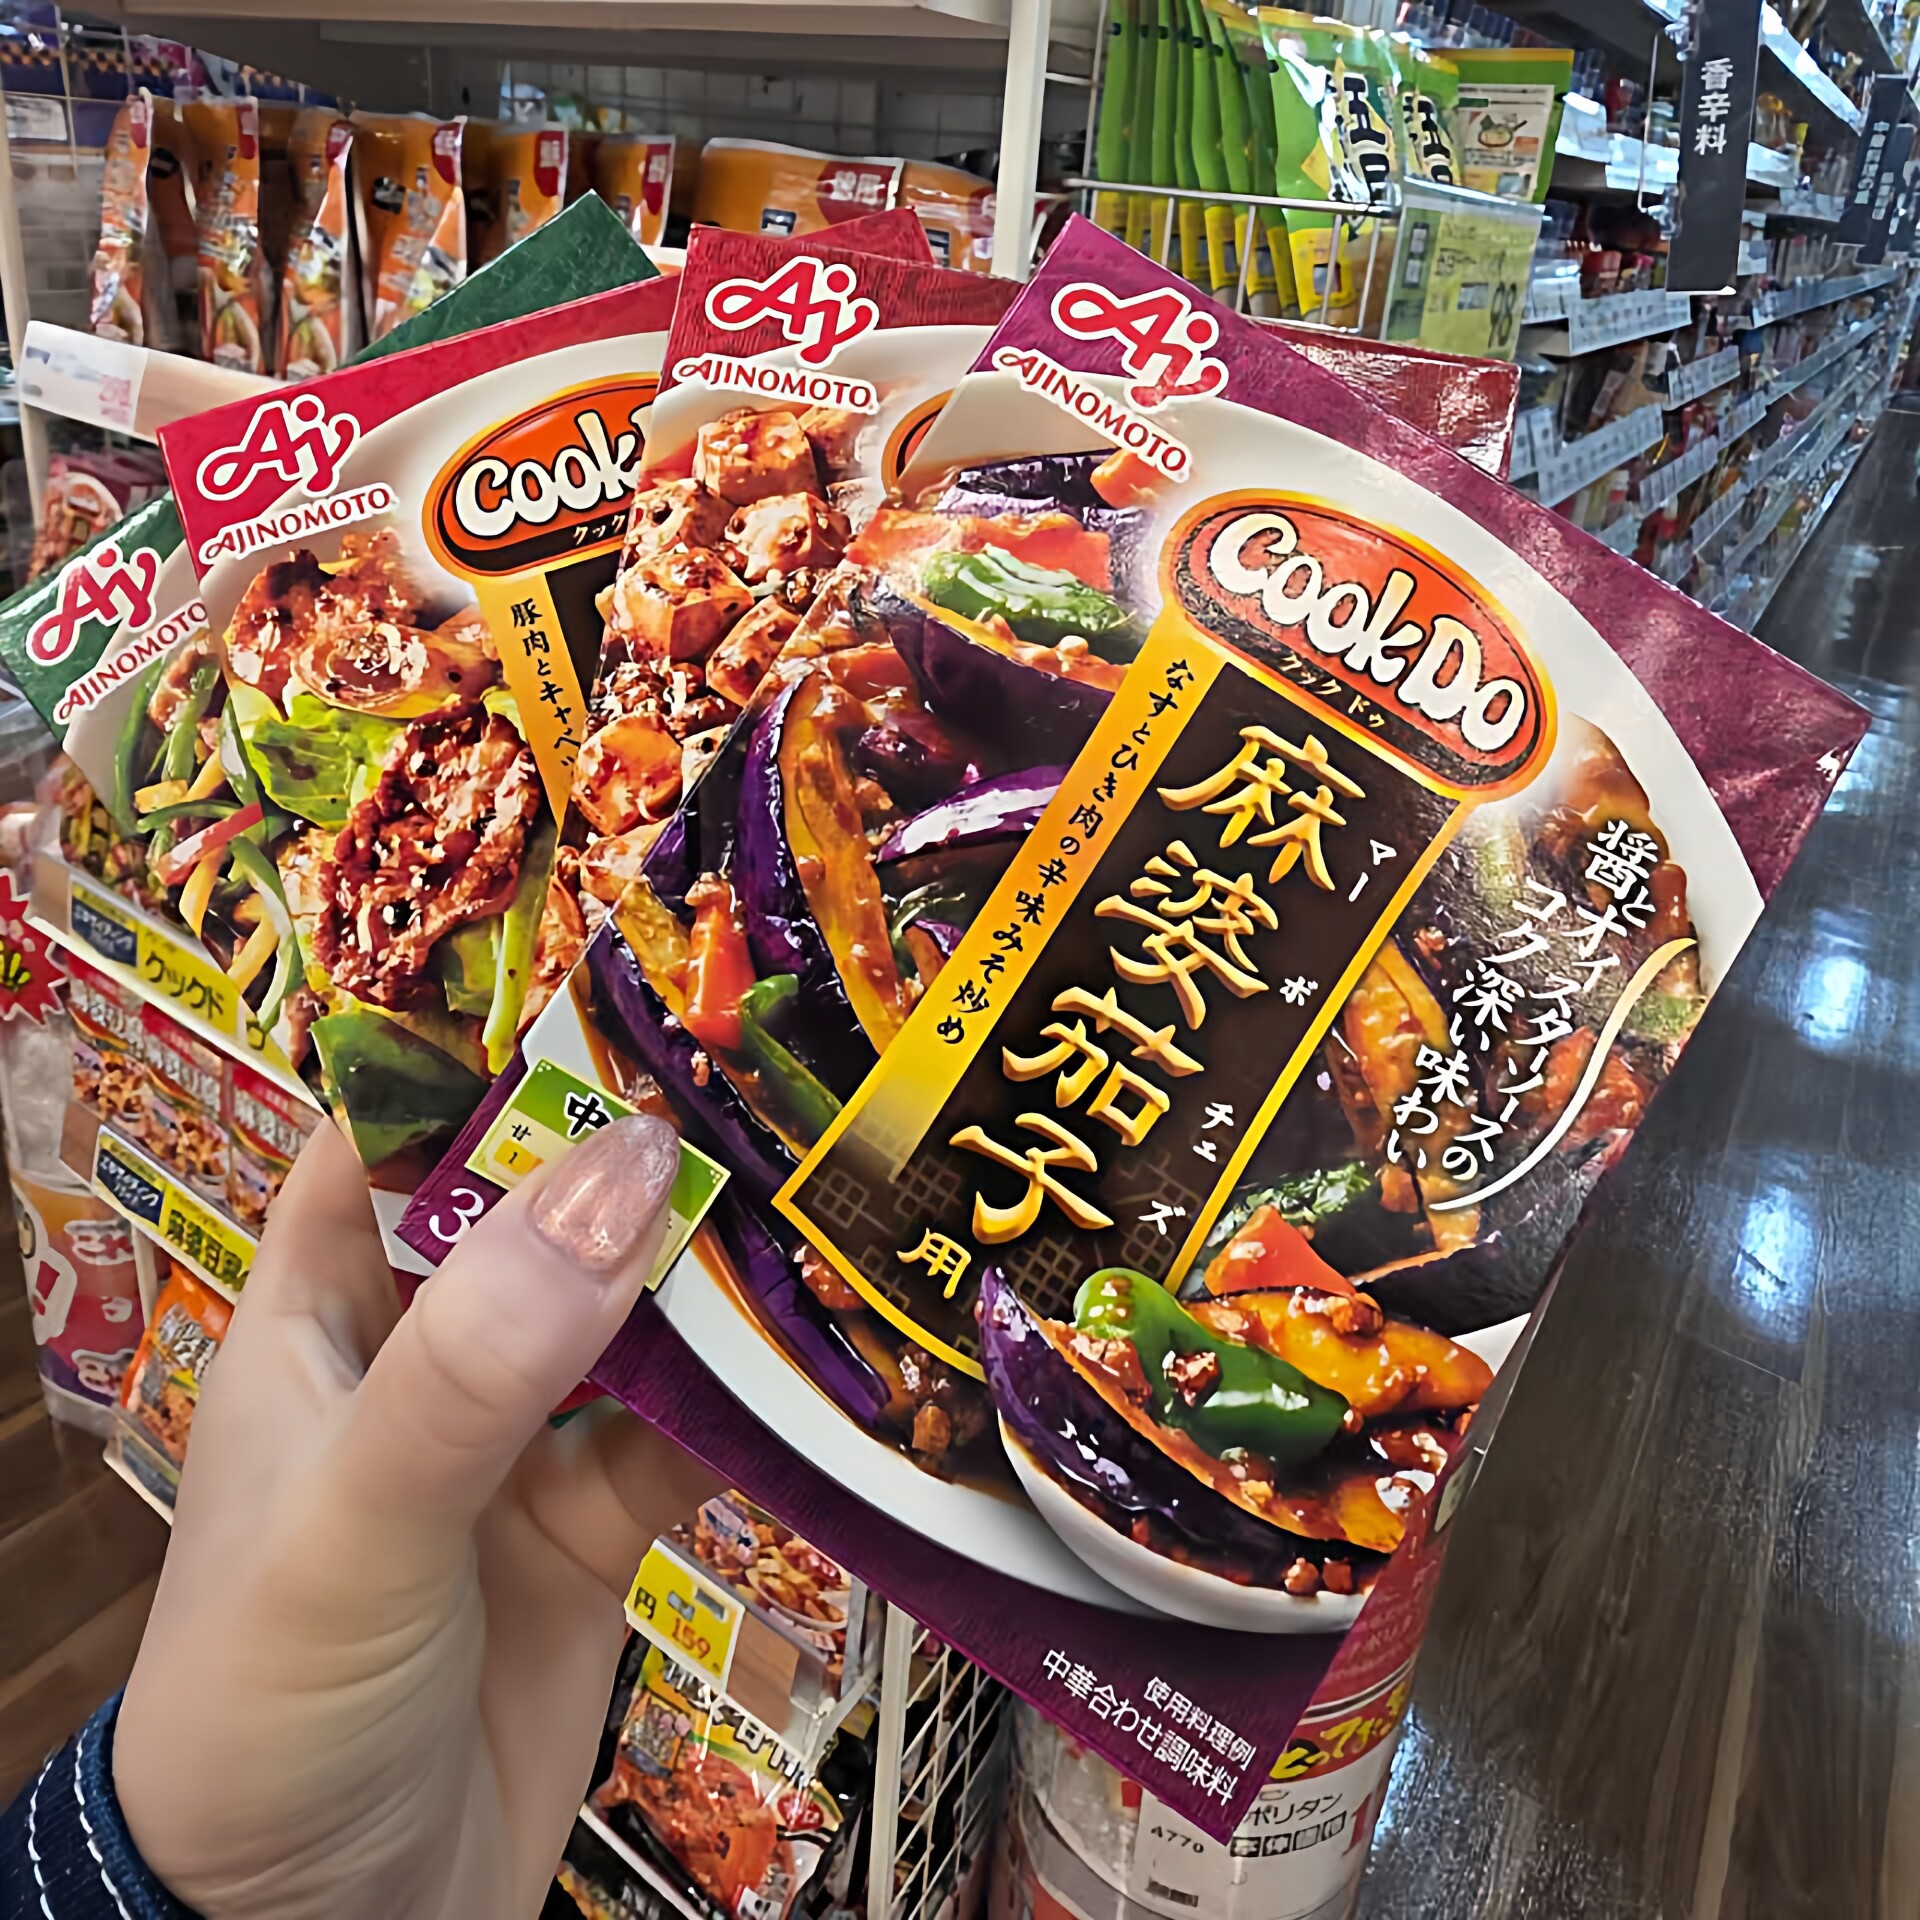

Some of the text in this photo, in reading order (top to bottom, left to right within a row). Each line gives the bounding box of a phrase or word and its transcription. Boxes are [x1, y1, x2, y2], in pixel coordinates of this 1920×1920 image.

[1695, 57, 1733, 156] 香辛料
[679, 356, 873, 409] AJINOMOTO
[998, 350, 1190, 475] AJINOMOTO
[204, 487, 392, 560] AJINOMOTO
[58, 602, 208, 720] AJINOMOTO
[935, 659, 1195, 1045] なすとひき肉の辛味みそ炒め
[1042, 1649, 1239, 1806] 中華合わせ調味料
[1143, 1676, 1257, 1771] 使用料理例
